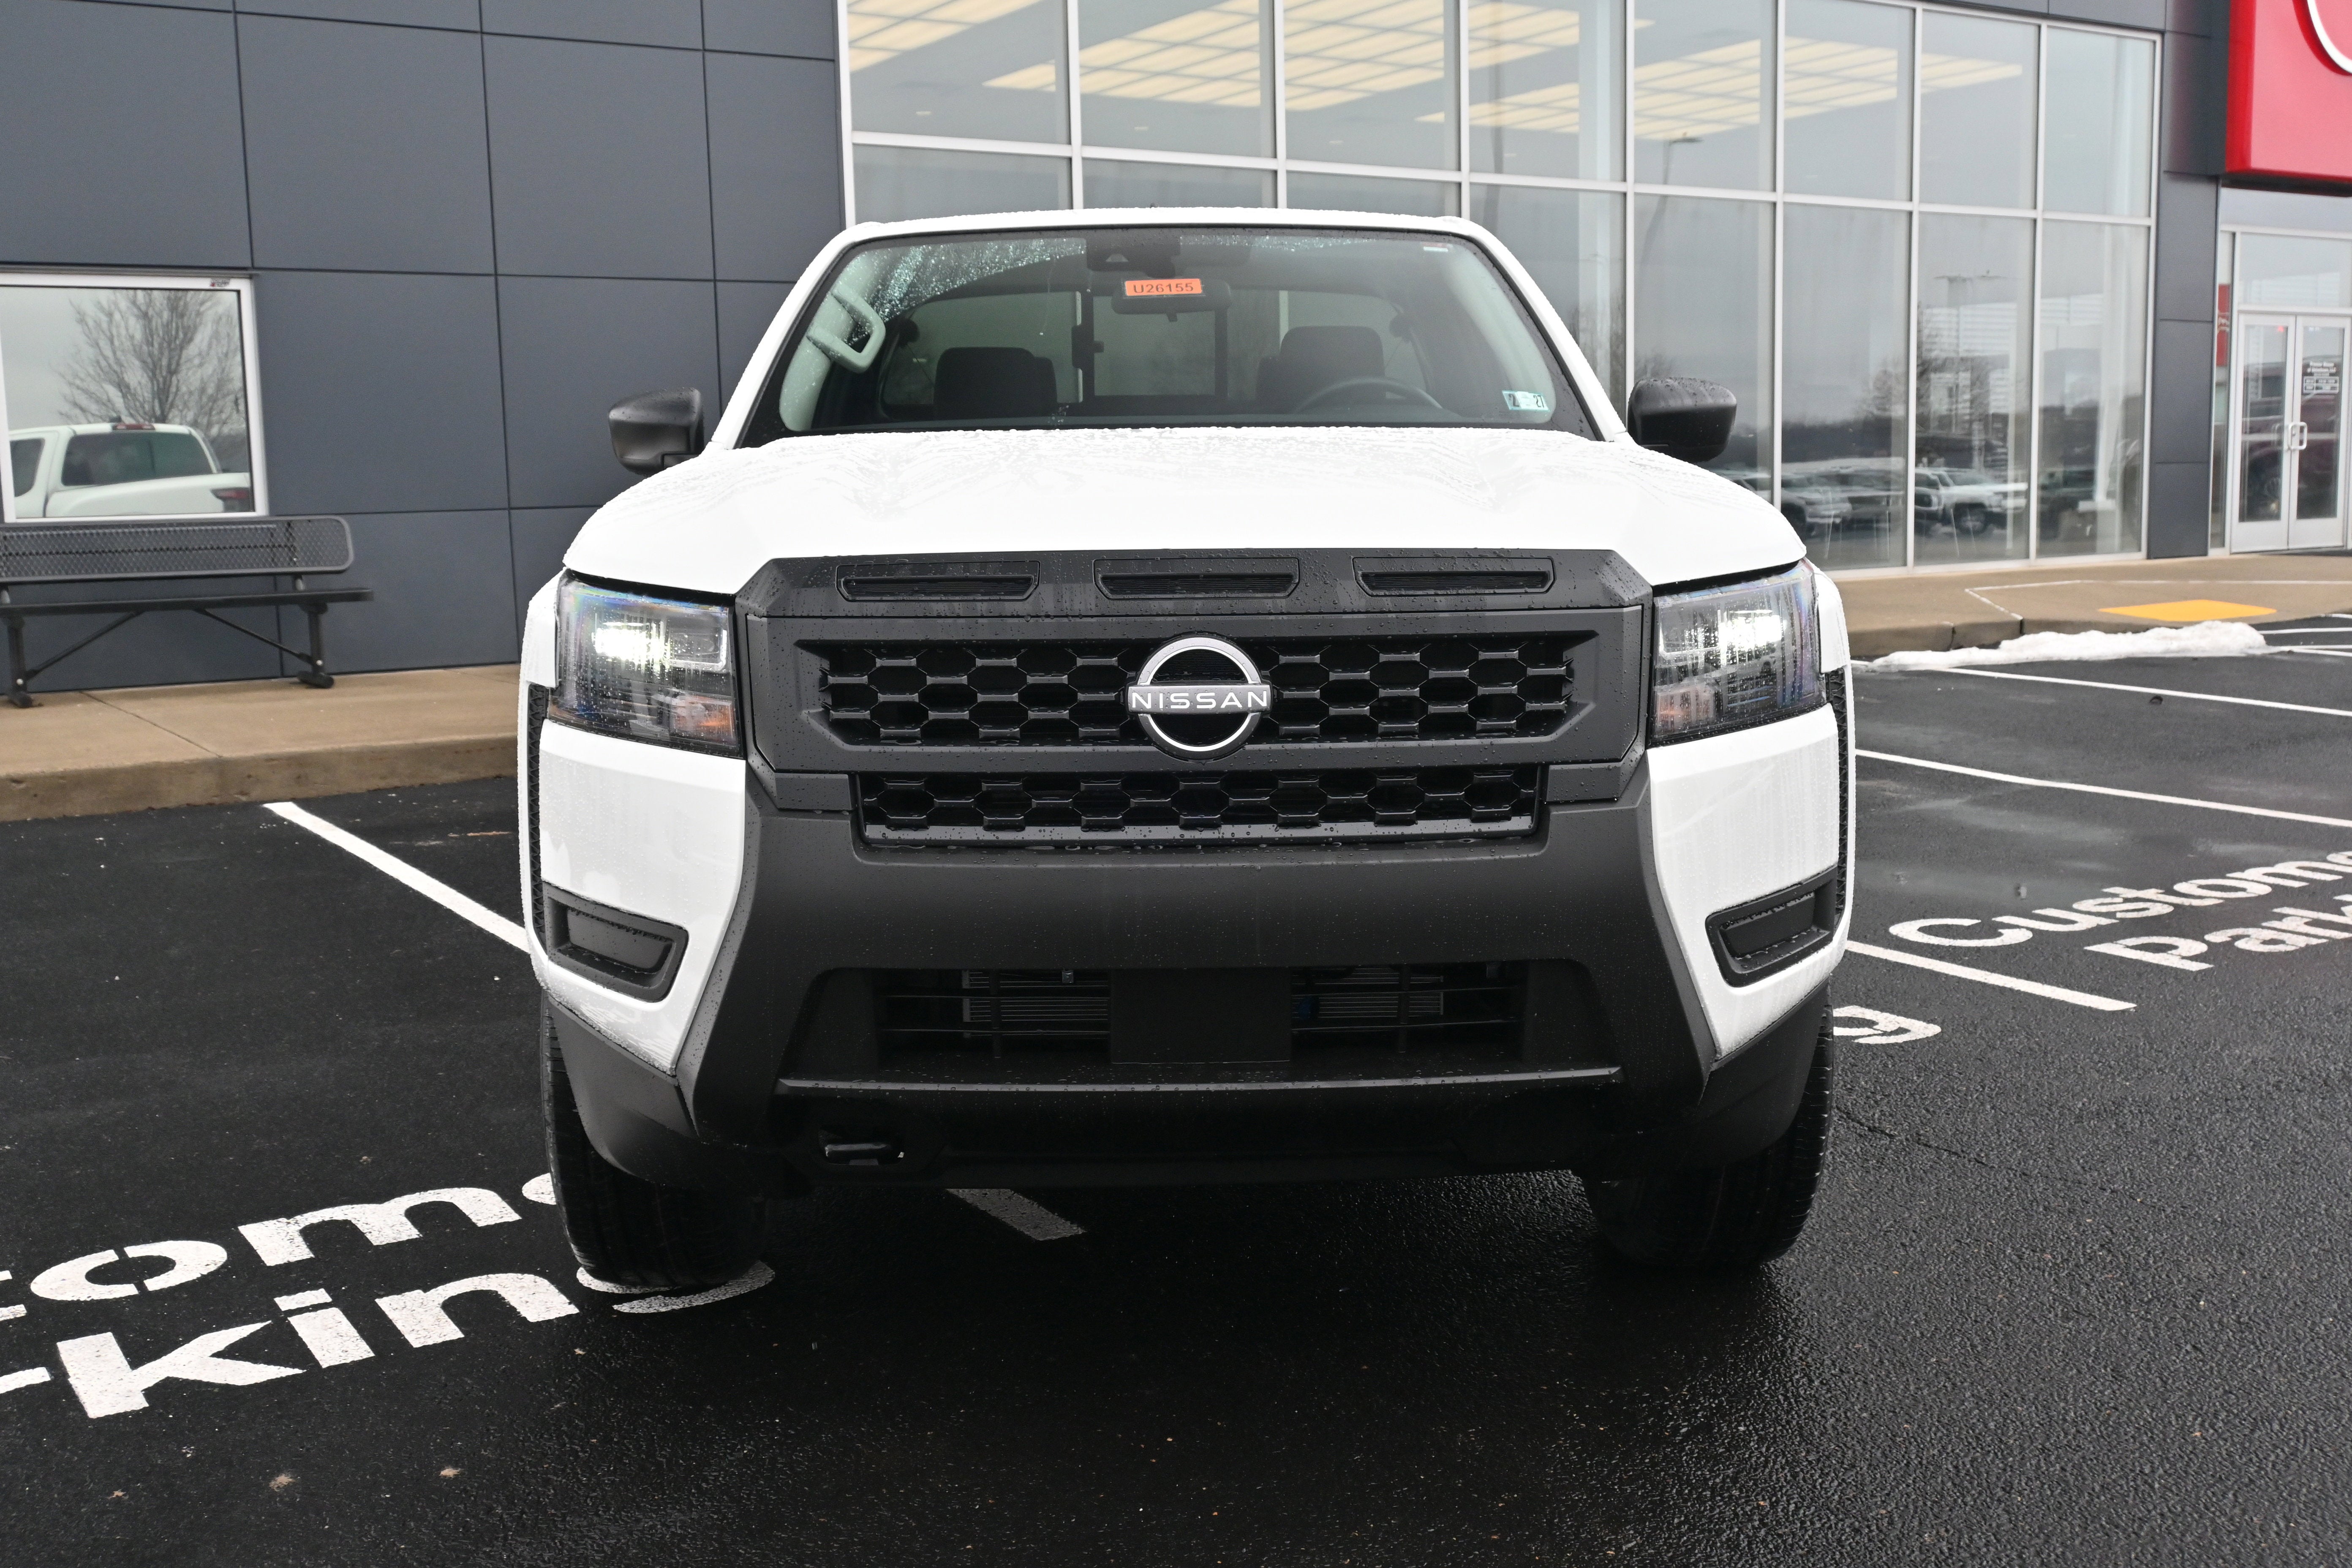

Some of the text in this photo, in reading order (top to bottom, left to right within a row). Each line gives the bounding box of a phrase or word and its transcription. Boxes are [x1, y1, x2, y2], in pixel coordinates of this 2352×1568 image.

[1133, 282, 1194, 293] U26155
[1508, 393, 1544, 408] 2 27
[1132, 690, 1268, 709] NISSAN
[1889, 851, 2352, 947] Custom
